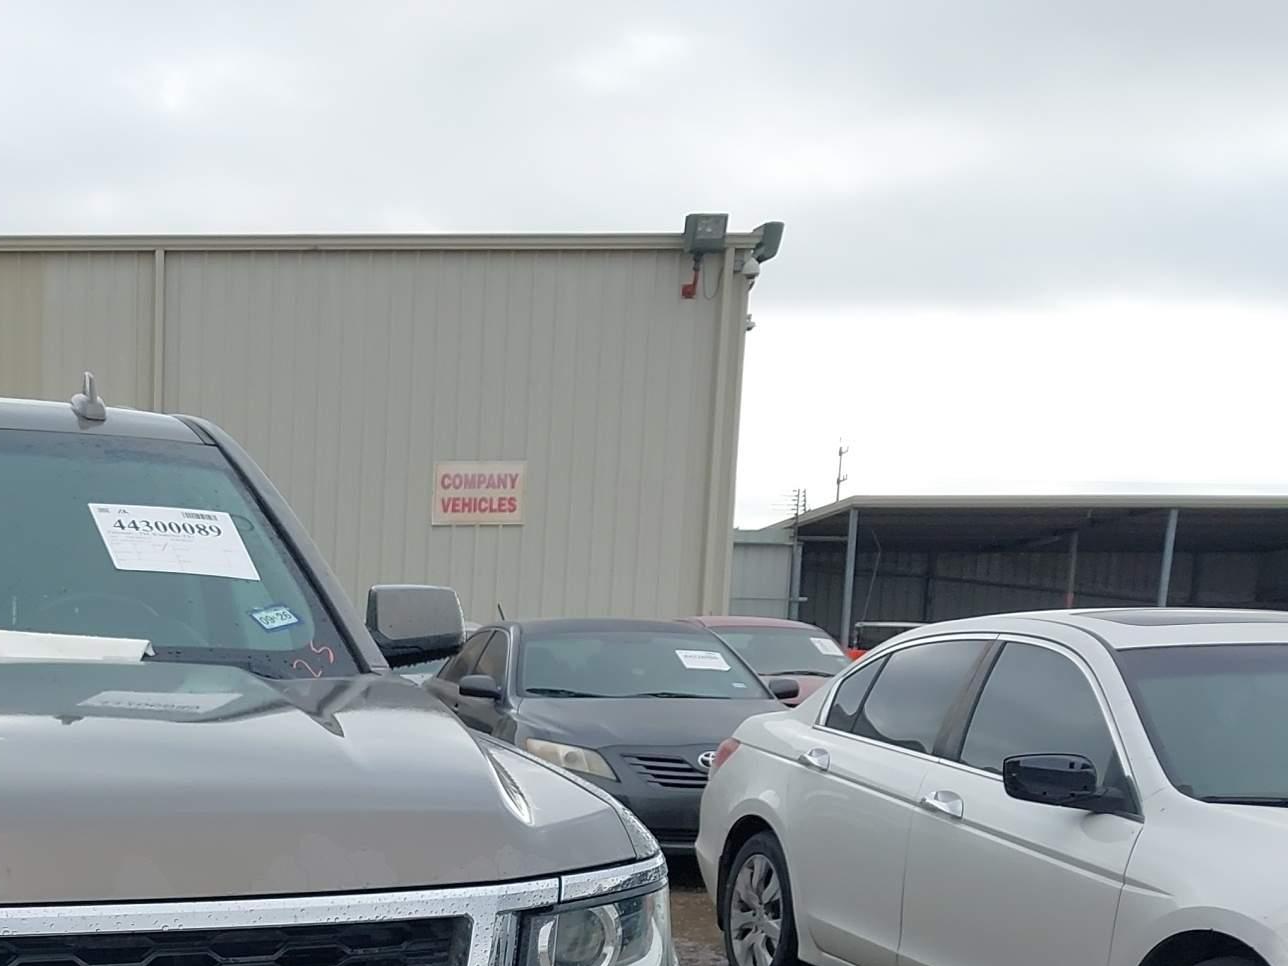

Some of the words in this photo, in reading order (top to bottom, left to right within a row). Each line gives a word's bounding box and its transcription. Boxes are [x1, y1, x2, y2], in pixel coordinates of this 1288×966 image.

[440, 472, 519, 490] COMPANY
[441, 496, 517, 513] VEHICLES
[113, 518, 222, 537] 44300089
